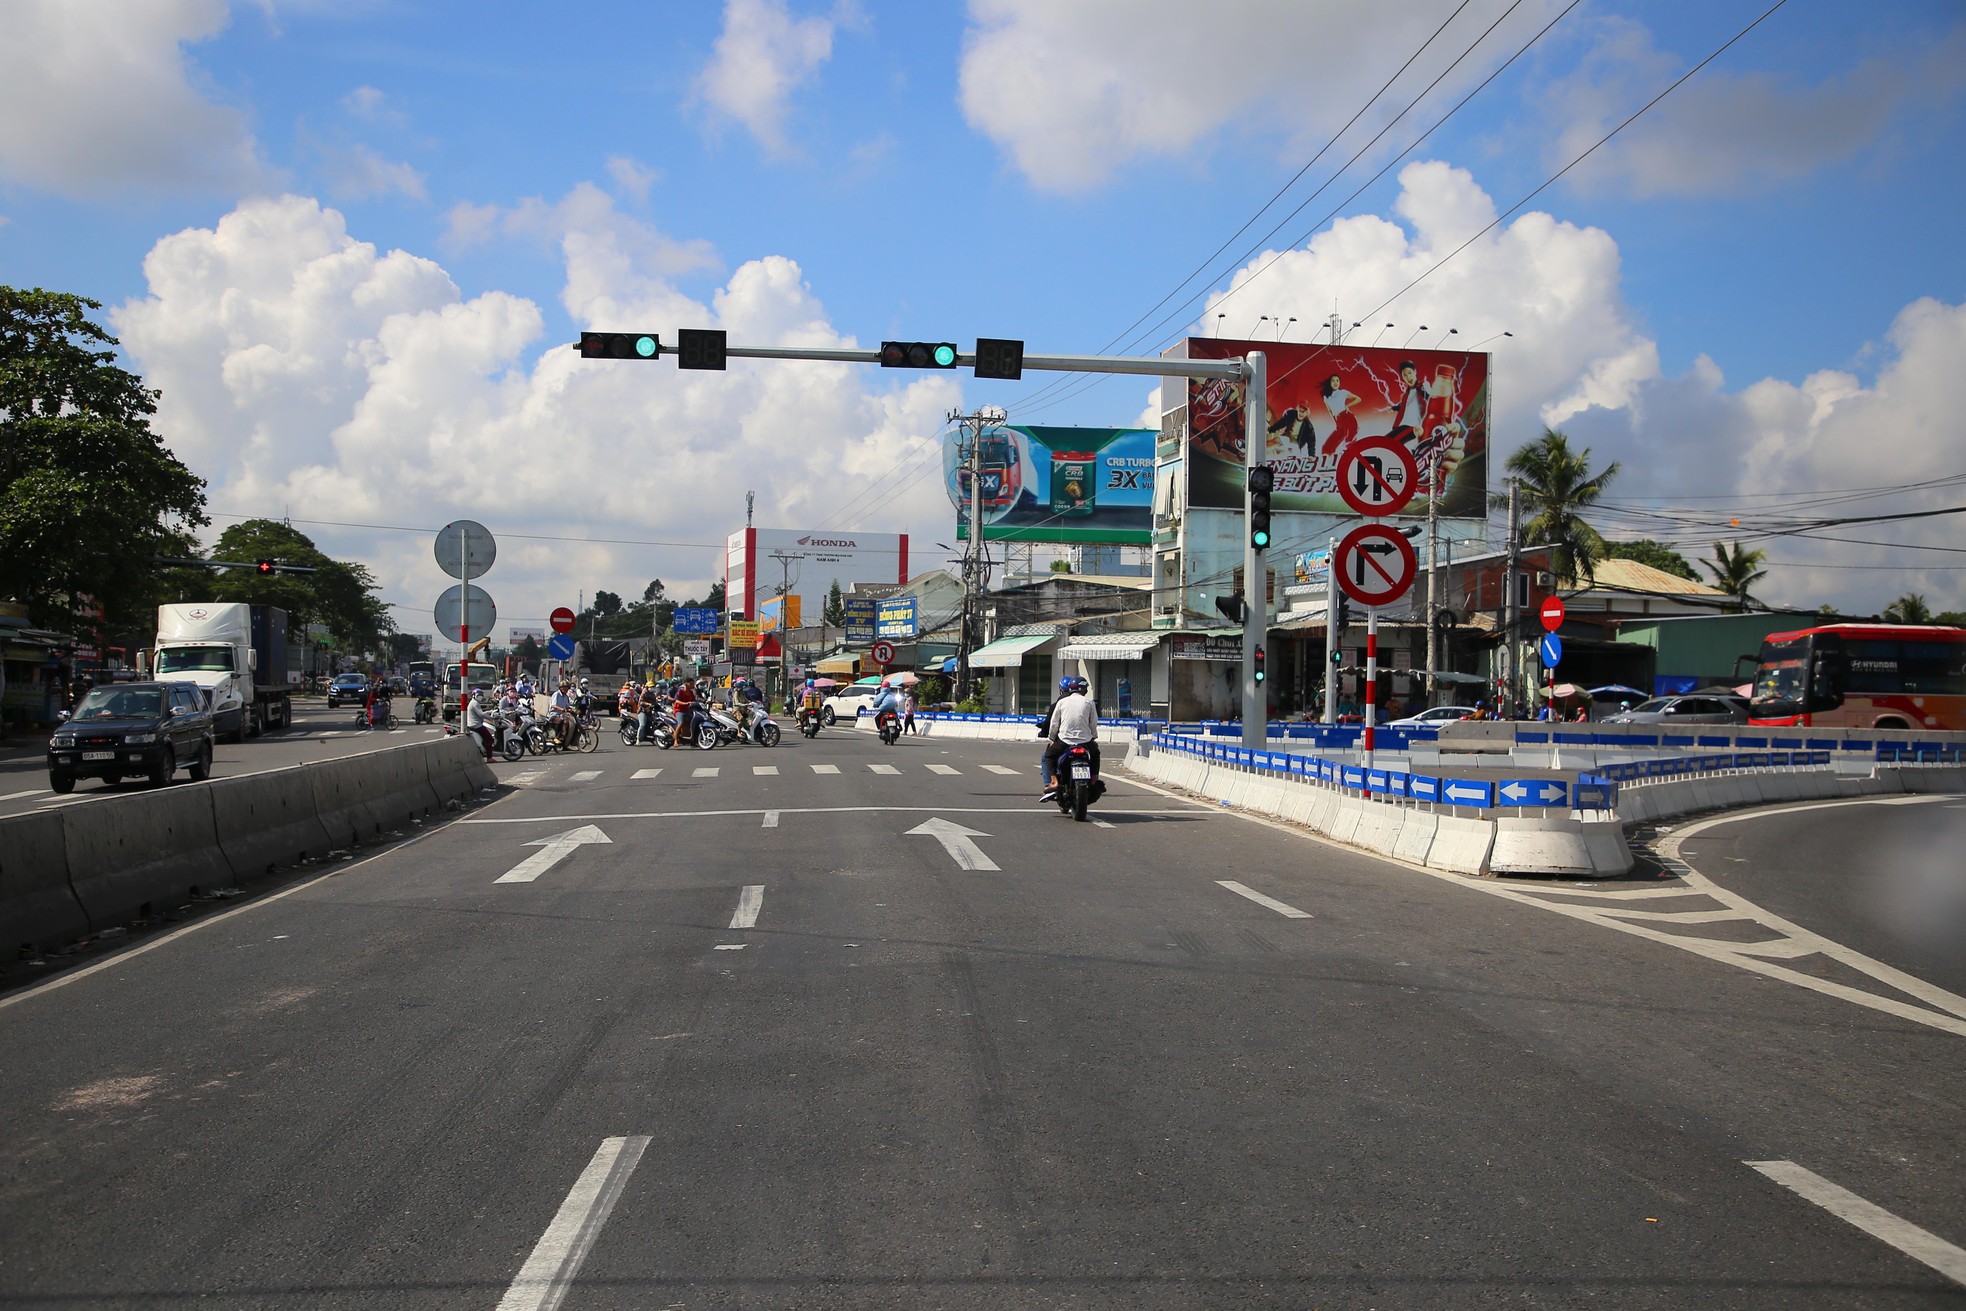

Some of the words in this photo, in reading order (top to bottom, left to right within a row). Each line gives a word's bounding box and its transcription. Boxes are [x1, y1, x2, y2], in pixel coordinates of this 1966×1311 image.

[1416, 433, 1454, 473] STING
[1106, 457, 1126, 467] CRB
[1107, 469, 1143, 490] 3X
[811, 539, 857, 548] HONDA
[1862, 660, 1898, 668] HYUNDAI
